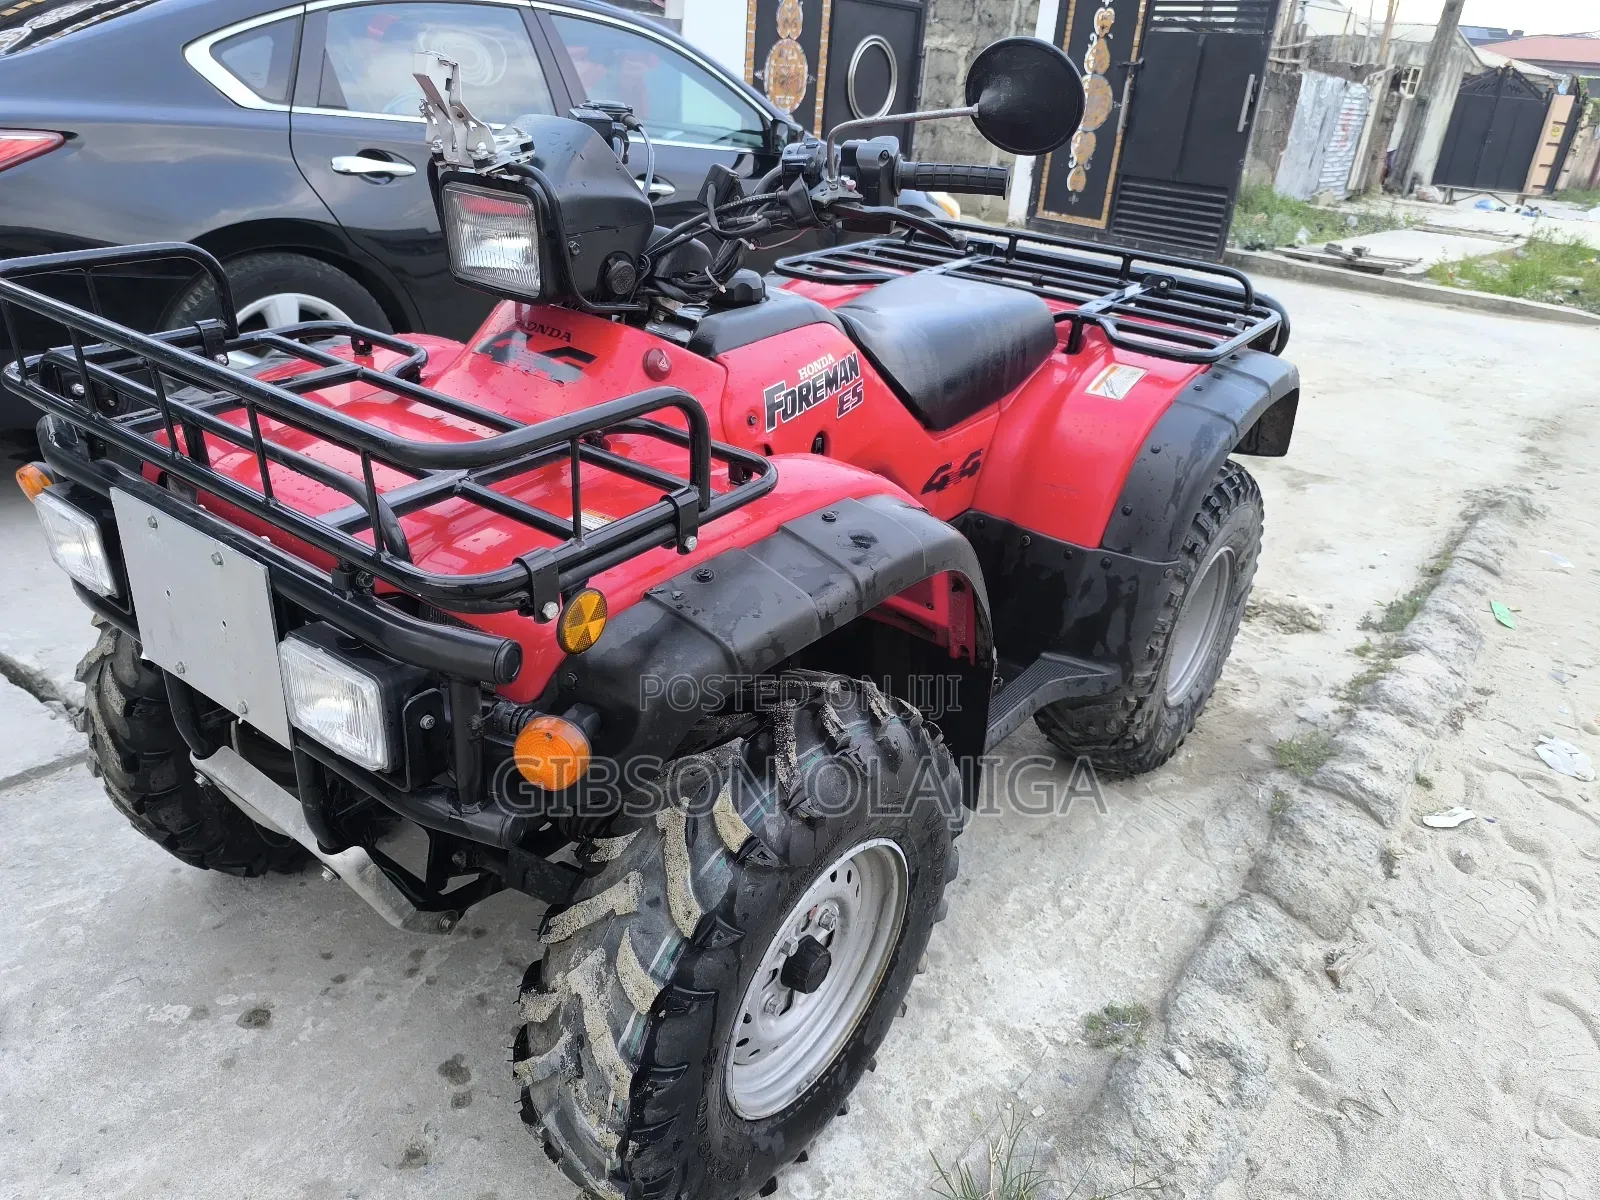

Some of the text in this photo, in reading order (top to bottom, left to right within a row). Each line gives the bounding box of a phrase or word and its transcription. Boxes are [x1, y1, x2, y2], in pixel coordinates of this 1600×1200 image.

[514, 319, 573, 344] HONDA
[797, 352, 835, 380] HONDA
[763, 350, 861, 433] FOREMAN
[836, 377, 864, 419] ES
